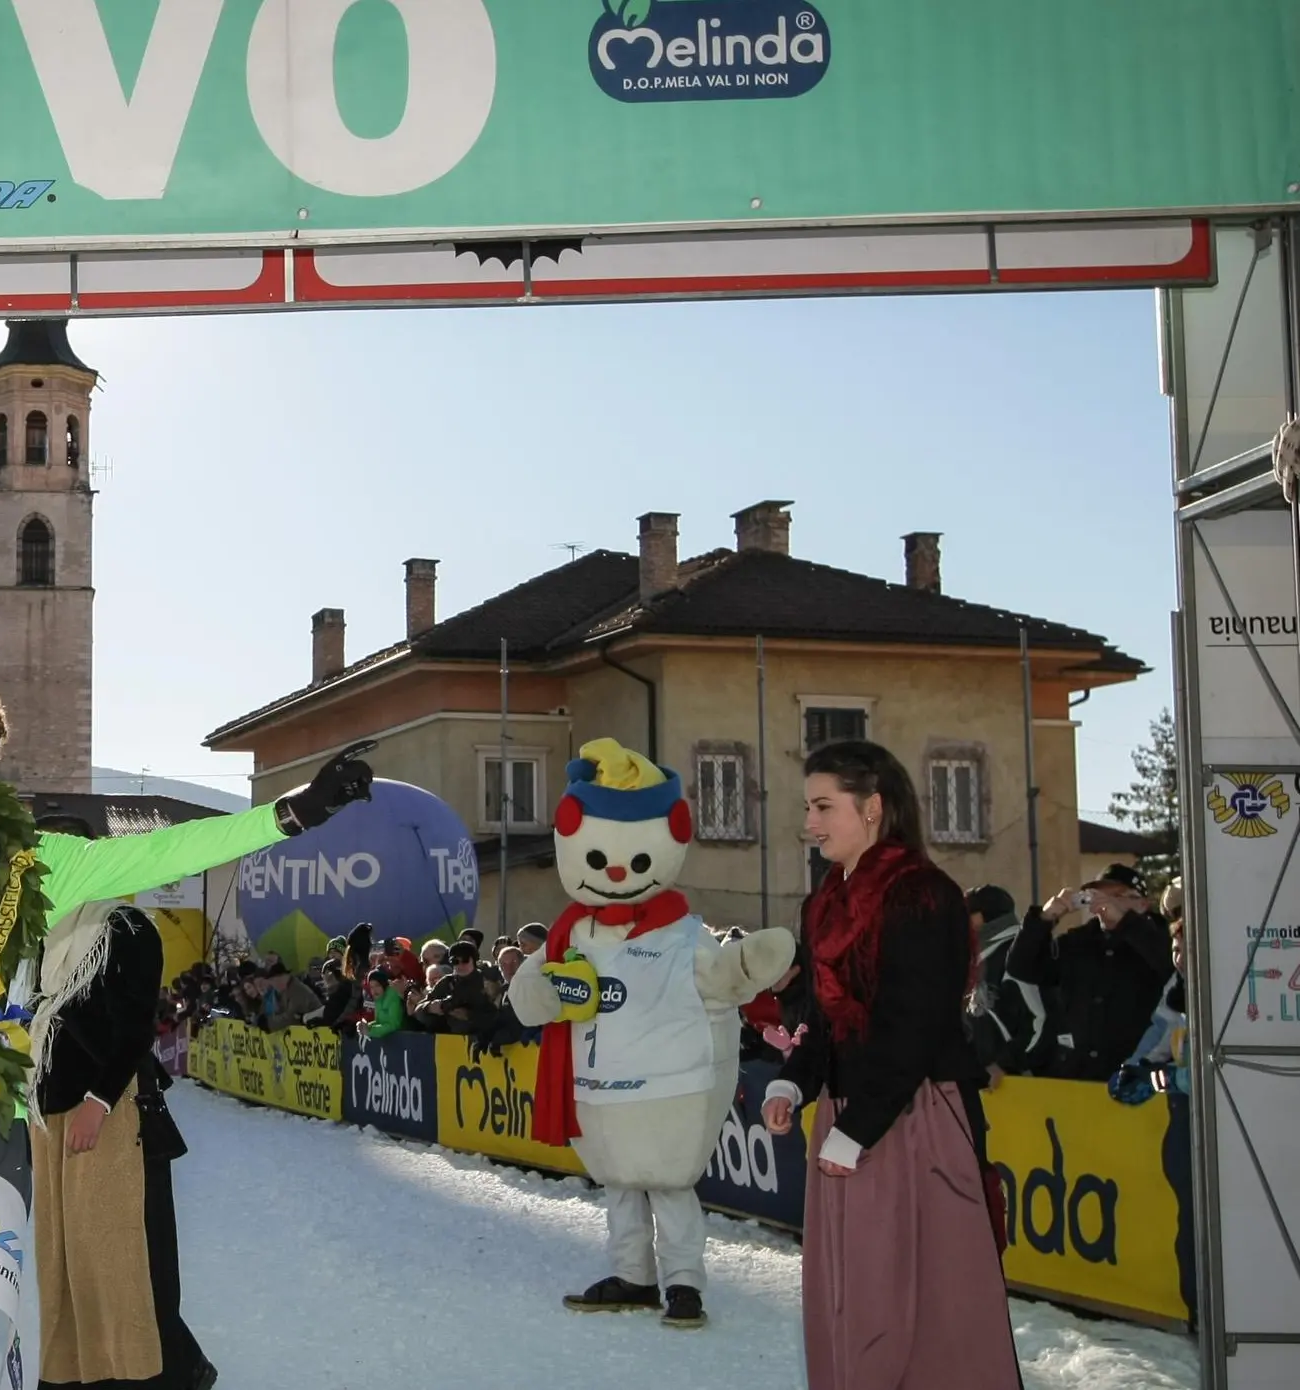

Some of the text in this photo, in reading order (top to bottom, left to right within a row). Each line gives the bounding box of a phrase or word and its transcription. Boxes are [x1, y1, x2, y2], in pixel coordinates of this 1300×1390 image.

[597, 15, 824, 70] Melinda
[706, 75, 731, 87] VAL
[736, 74, 749, 85] DI
[755, 73, 789, 85] NON
[292, 1068, 331, 1114] Trentine
[352, 1046, 423, 1123] Melinda
[456, 1057, 535, 1140] Melin
